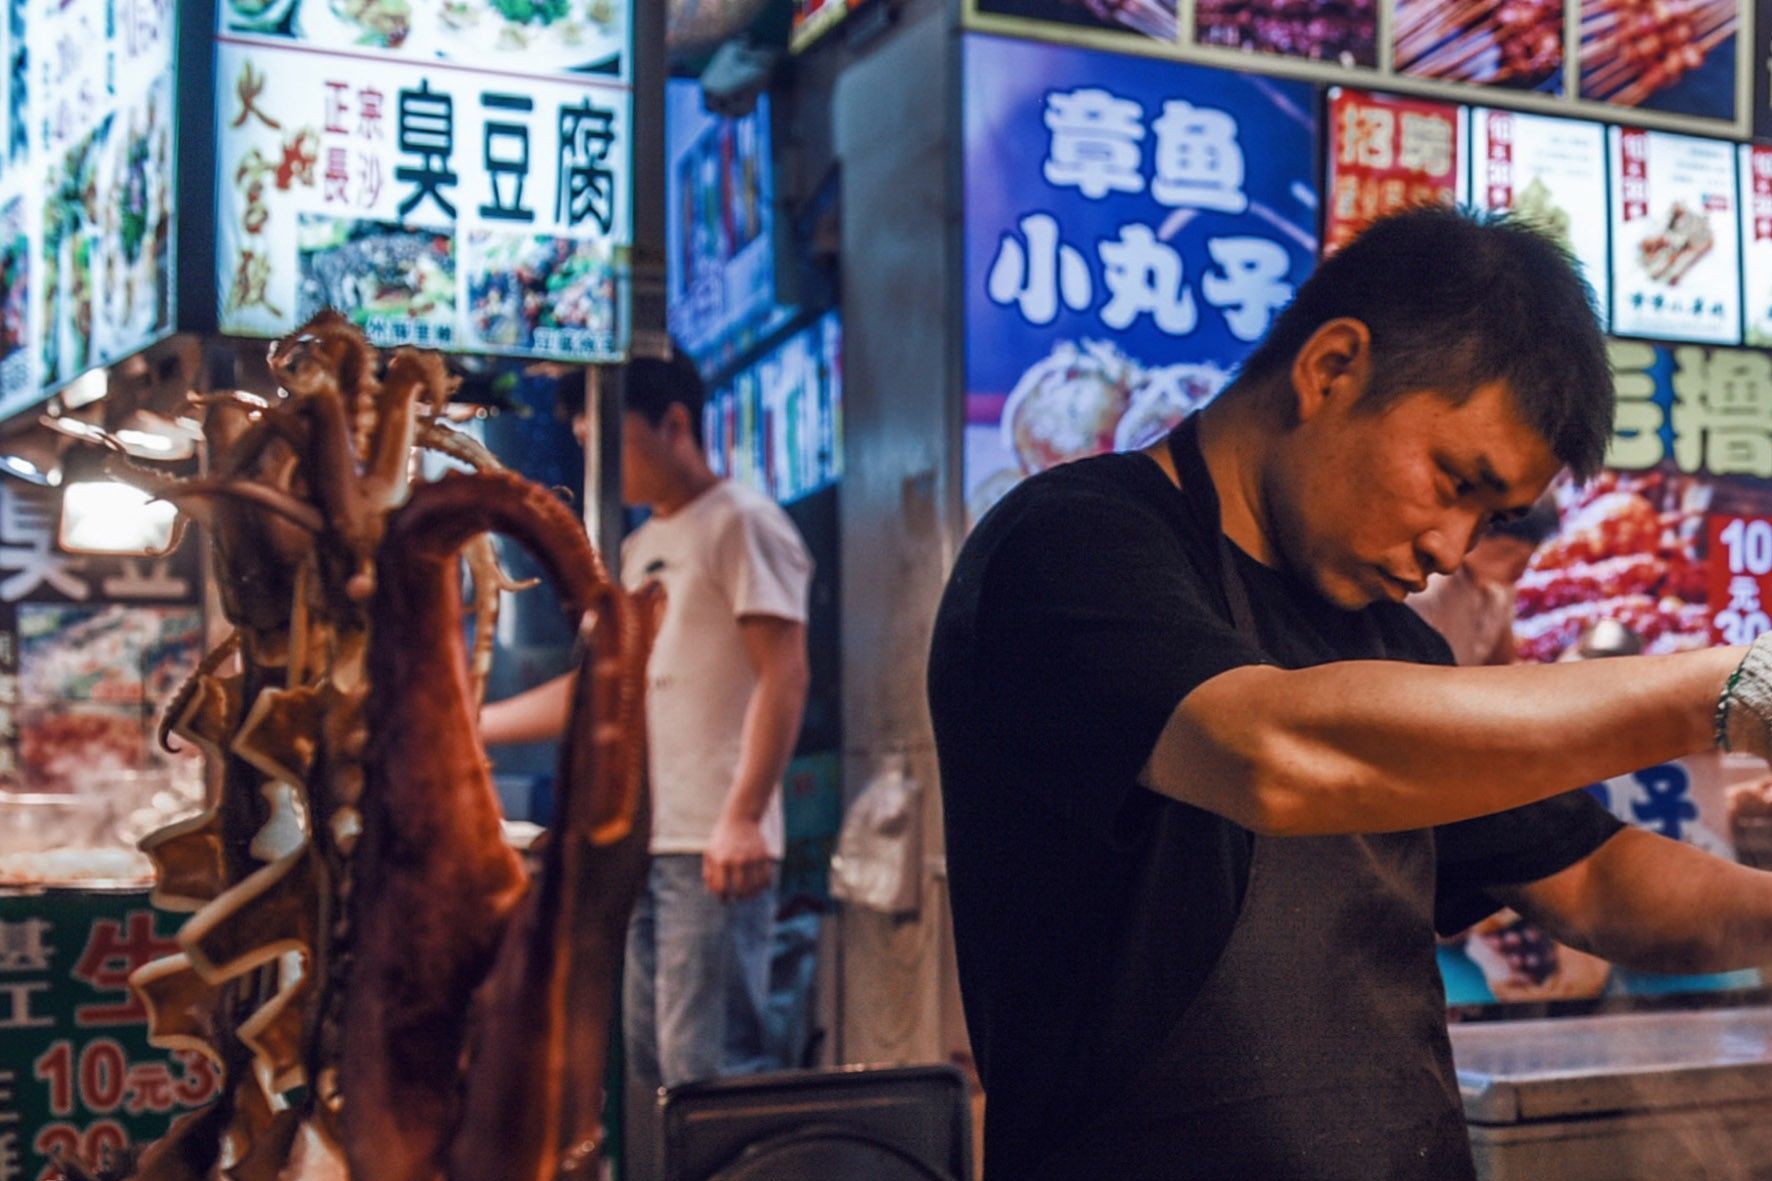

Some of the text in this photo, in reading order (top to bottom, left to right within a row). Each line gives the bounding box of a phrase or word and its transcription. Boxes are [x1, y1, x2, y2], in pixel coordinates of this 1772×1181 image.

[324, 80, 384, 140] 正宗
[396, 77, 616, 236] 臭豆腐
[1043, 88, 1248, 214] 章鱼
[989, 213, 1294, 342] 小丸子
